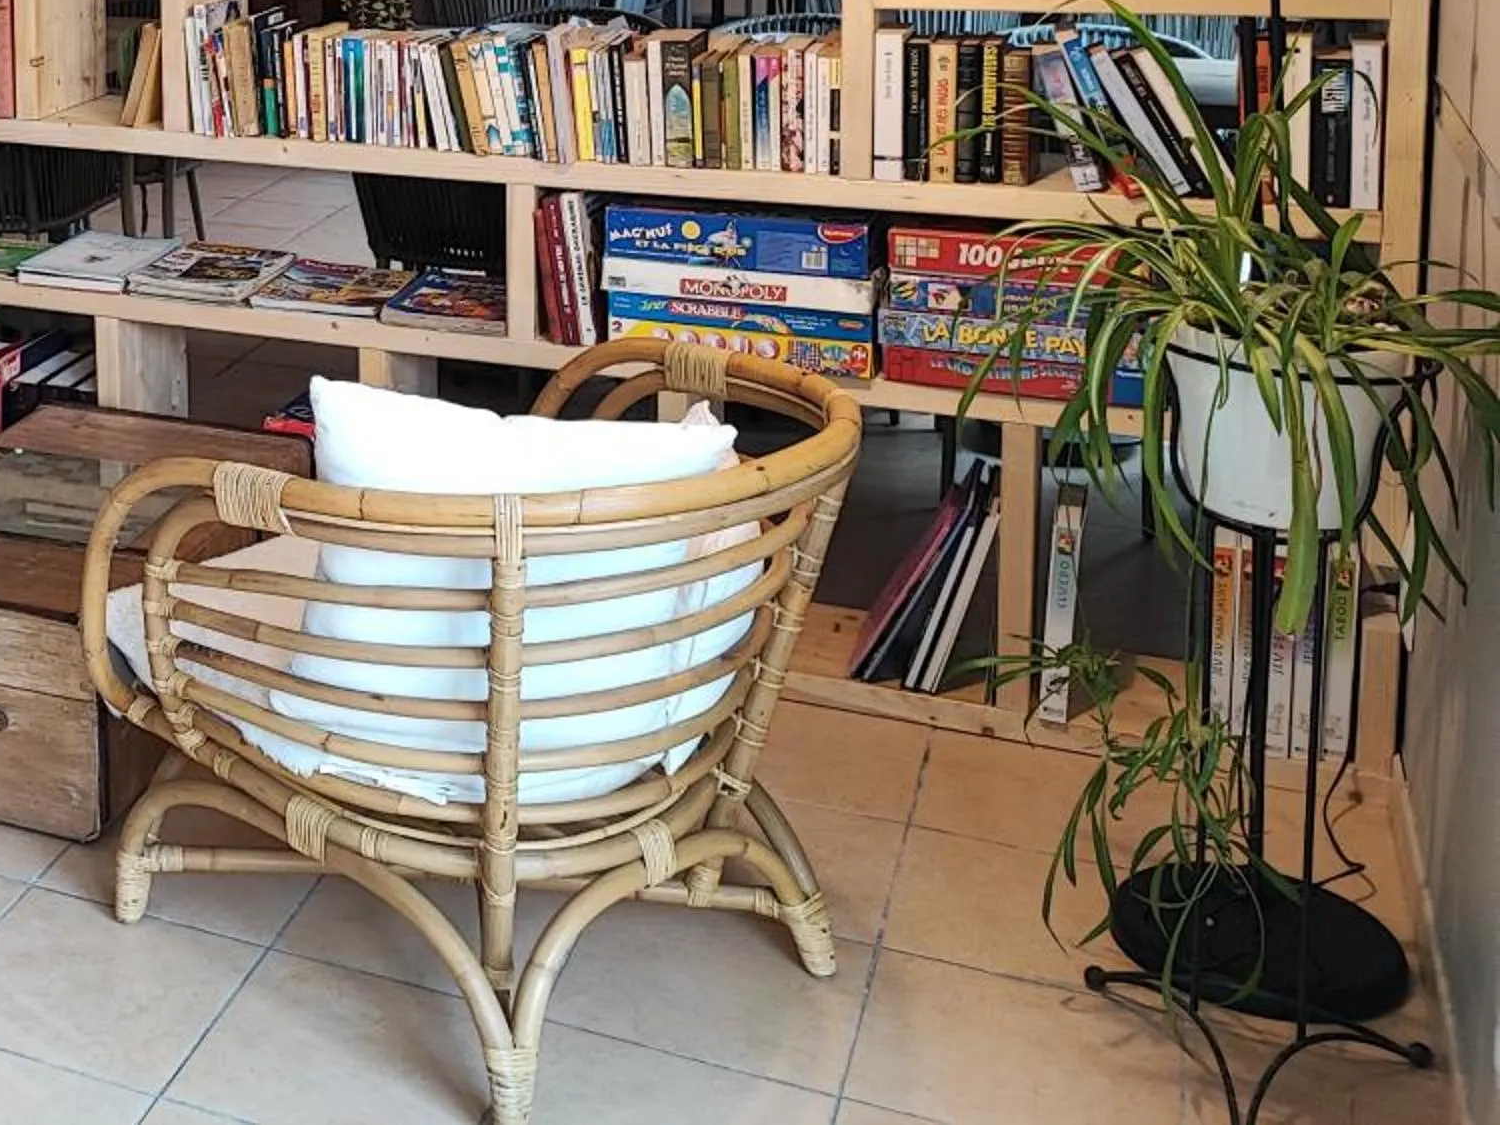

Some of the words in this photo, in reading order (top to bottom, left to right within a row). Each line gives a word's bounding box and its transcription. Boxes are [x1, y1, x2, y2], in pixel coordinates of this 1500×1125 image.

[635, 239, 649, 248] ET
[653, 241, 671, 250] LA
[958, 242, 1003, 267] 100
[683, 279, 785, 301] MONOPOLY
[671, 301, 745, 321] SCRABBLE
[923, 322, 950, 344] LA
[958, 325, 1038, 348] BONE
